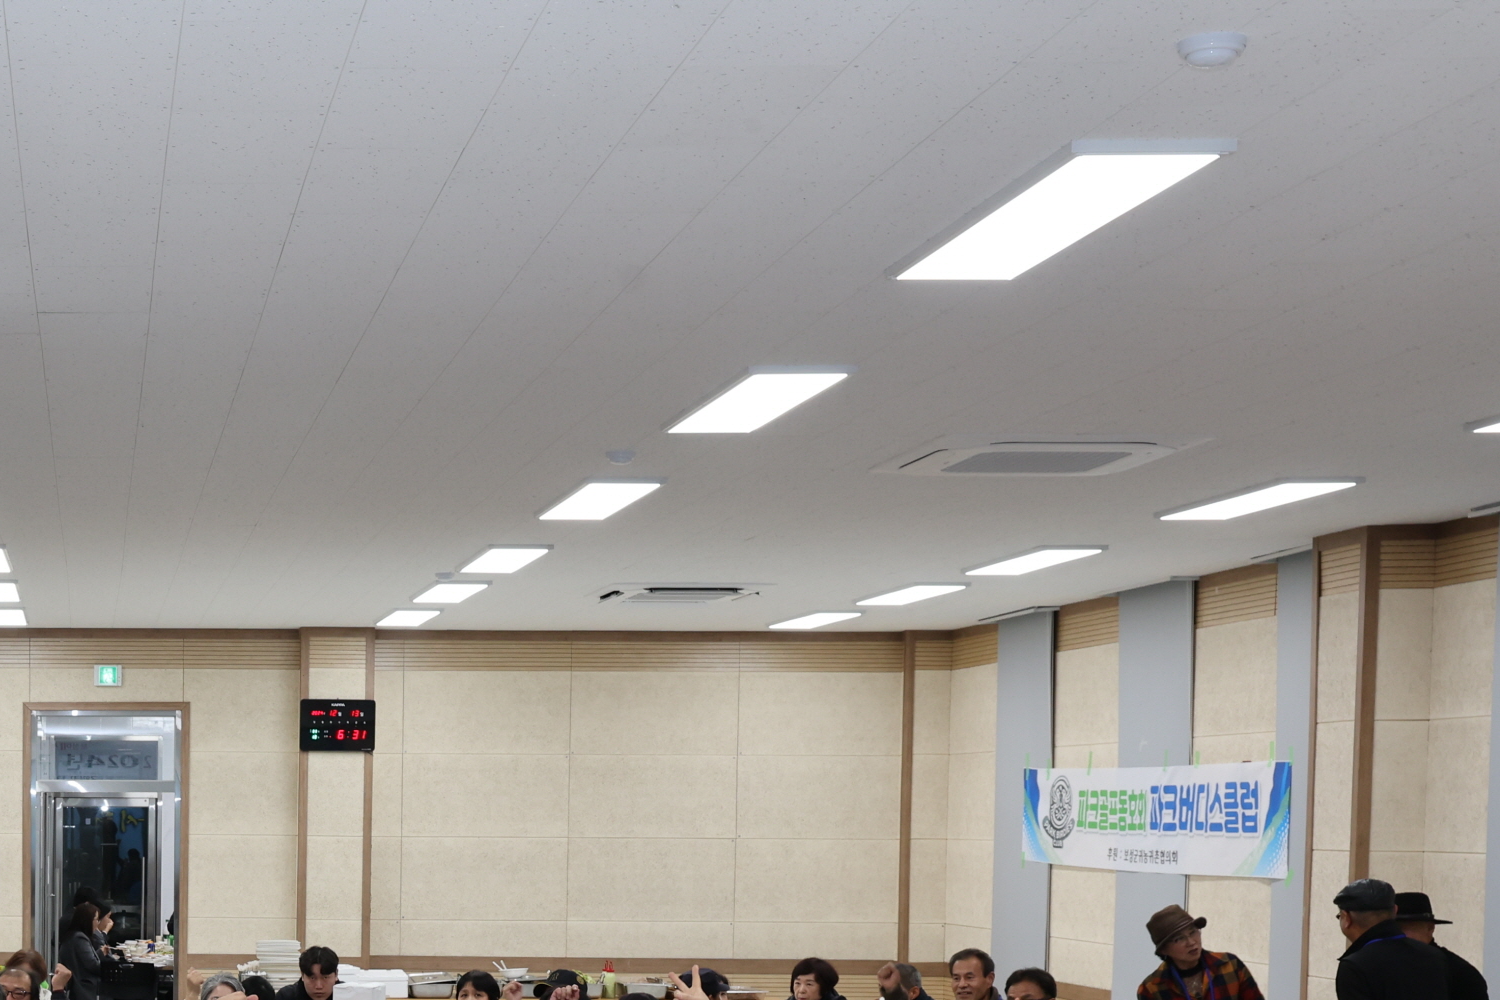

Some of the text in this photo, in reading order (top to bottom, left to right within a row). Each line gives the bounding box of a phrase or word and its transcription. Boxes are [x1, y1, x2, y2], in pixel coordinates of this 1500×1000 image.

[1076, 780, 1259, 833] 파크골프동호회 파크버디스클럽
[1107, 847, 1118, 862] 후원
